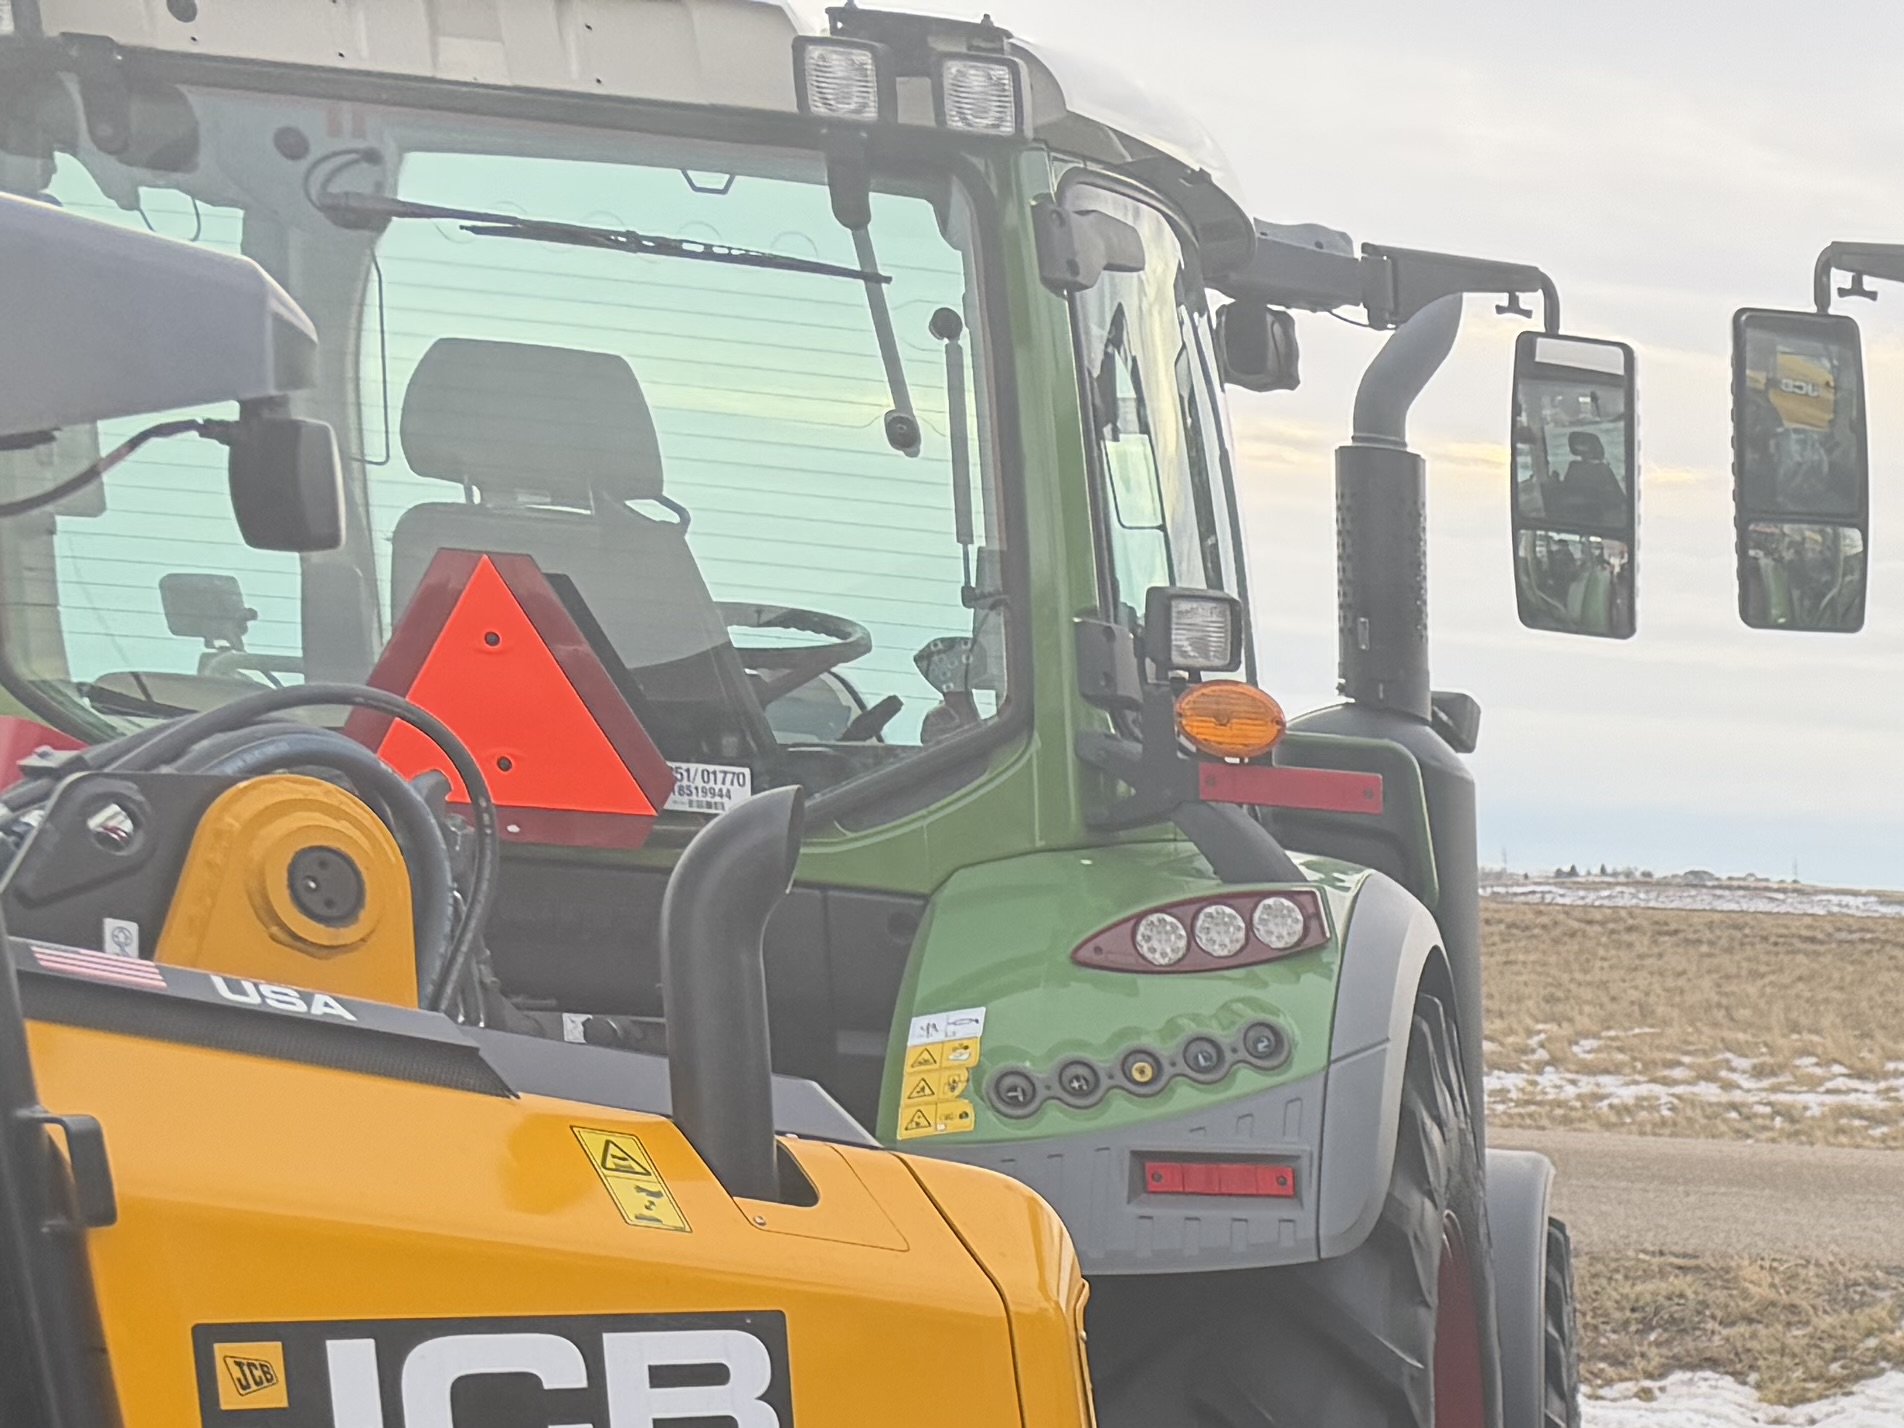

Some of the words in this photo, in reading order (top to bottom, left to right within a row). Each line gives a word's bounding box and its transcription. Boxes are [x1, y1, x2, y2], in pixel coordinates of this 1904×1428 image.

[672, 766, 746, 788] 51/01770
[209, 974, 358, 1022] USA
[233, 1359, 274, 1391] JCB
